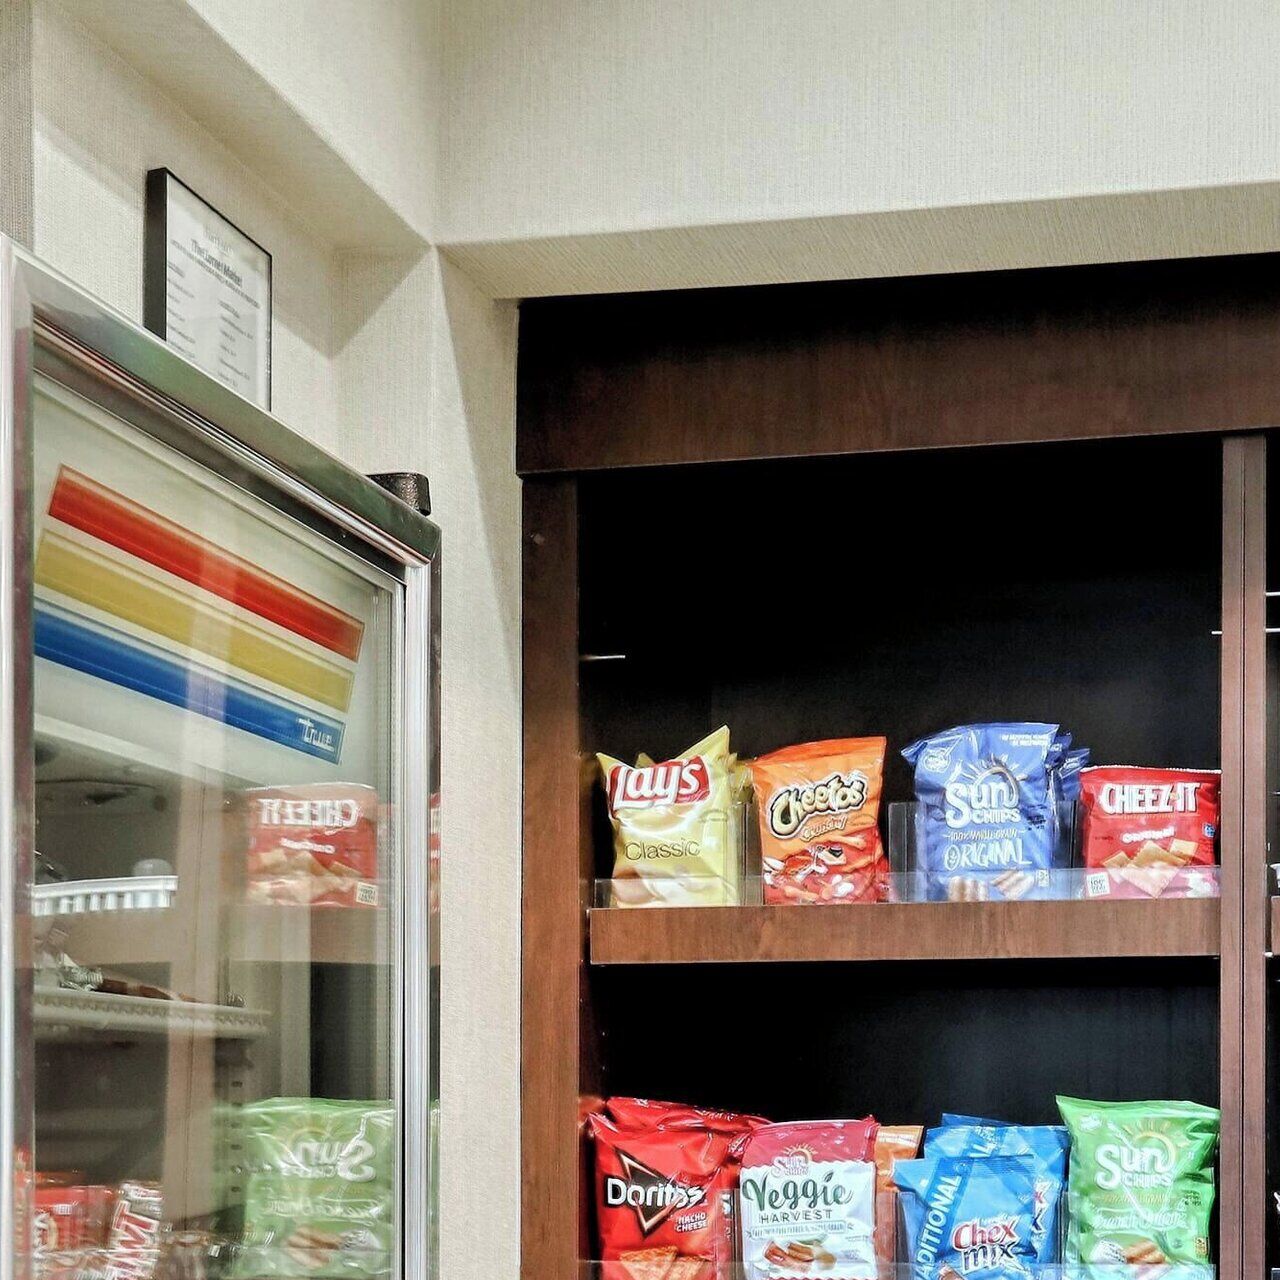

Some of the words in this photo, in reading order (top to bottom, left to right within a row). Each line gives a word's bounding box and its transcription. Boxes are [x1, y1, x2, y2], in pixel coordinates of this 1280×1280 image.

[612, 760, 702, 810] Lay's
[1100, 782, 1201, 816] CHEEZ-IT
[770, 775, 867, 838] Cheetos
[624, 838, 701, 861] Classic
[943, 838, 1033, 872] ORIGINAL
[606, 1177, 705, 1209] Doritos
[742, 1172, 853, 1211] Veggie
[675, 1220, 709, 1233] CHEESE
[677, 1212, 707, 1226] NACHO
[760, 1209, 833, 1224] HARVEST
[952, 1218, 1019, 1250] Chex
[963, 1242, 1017, 1272] mix
